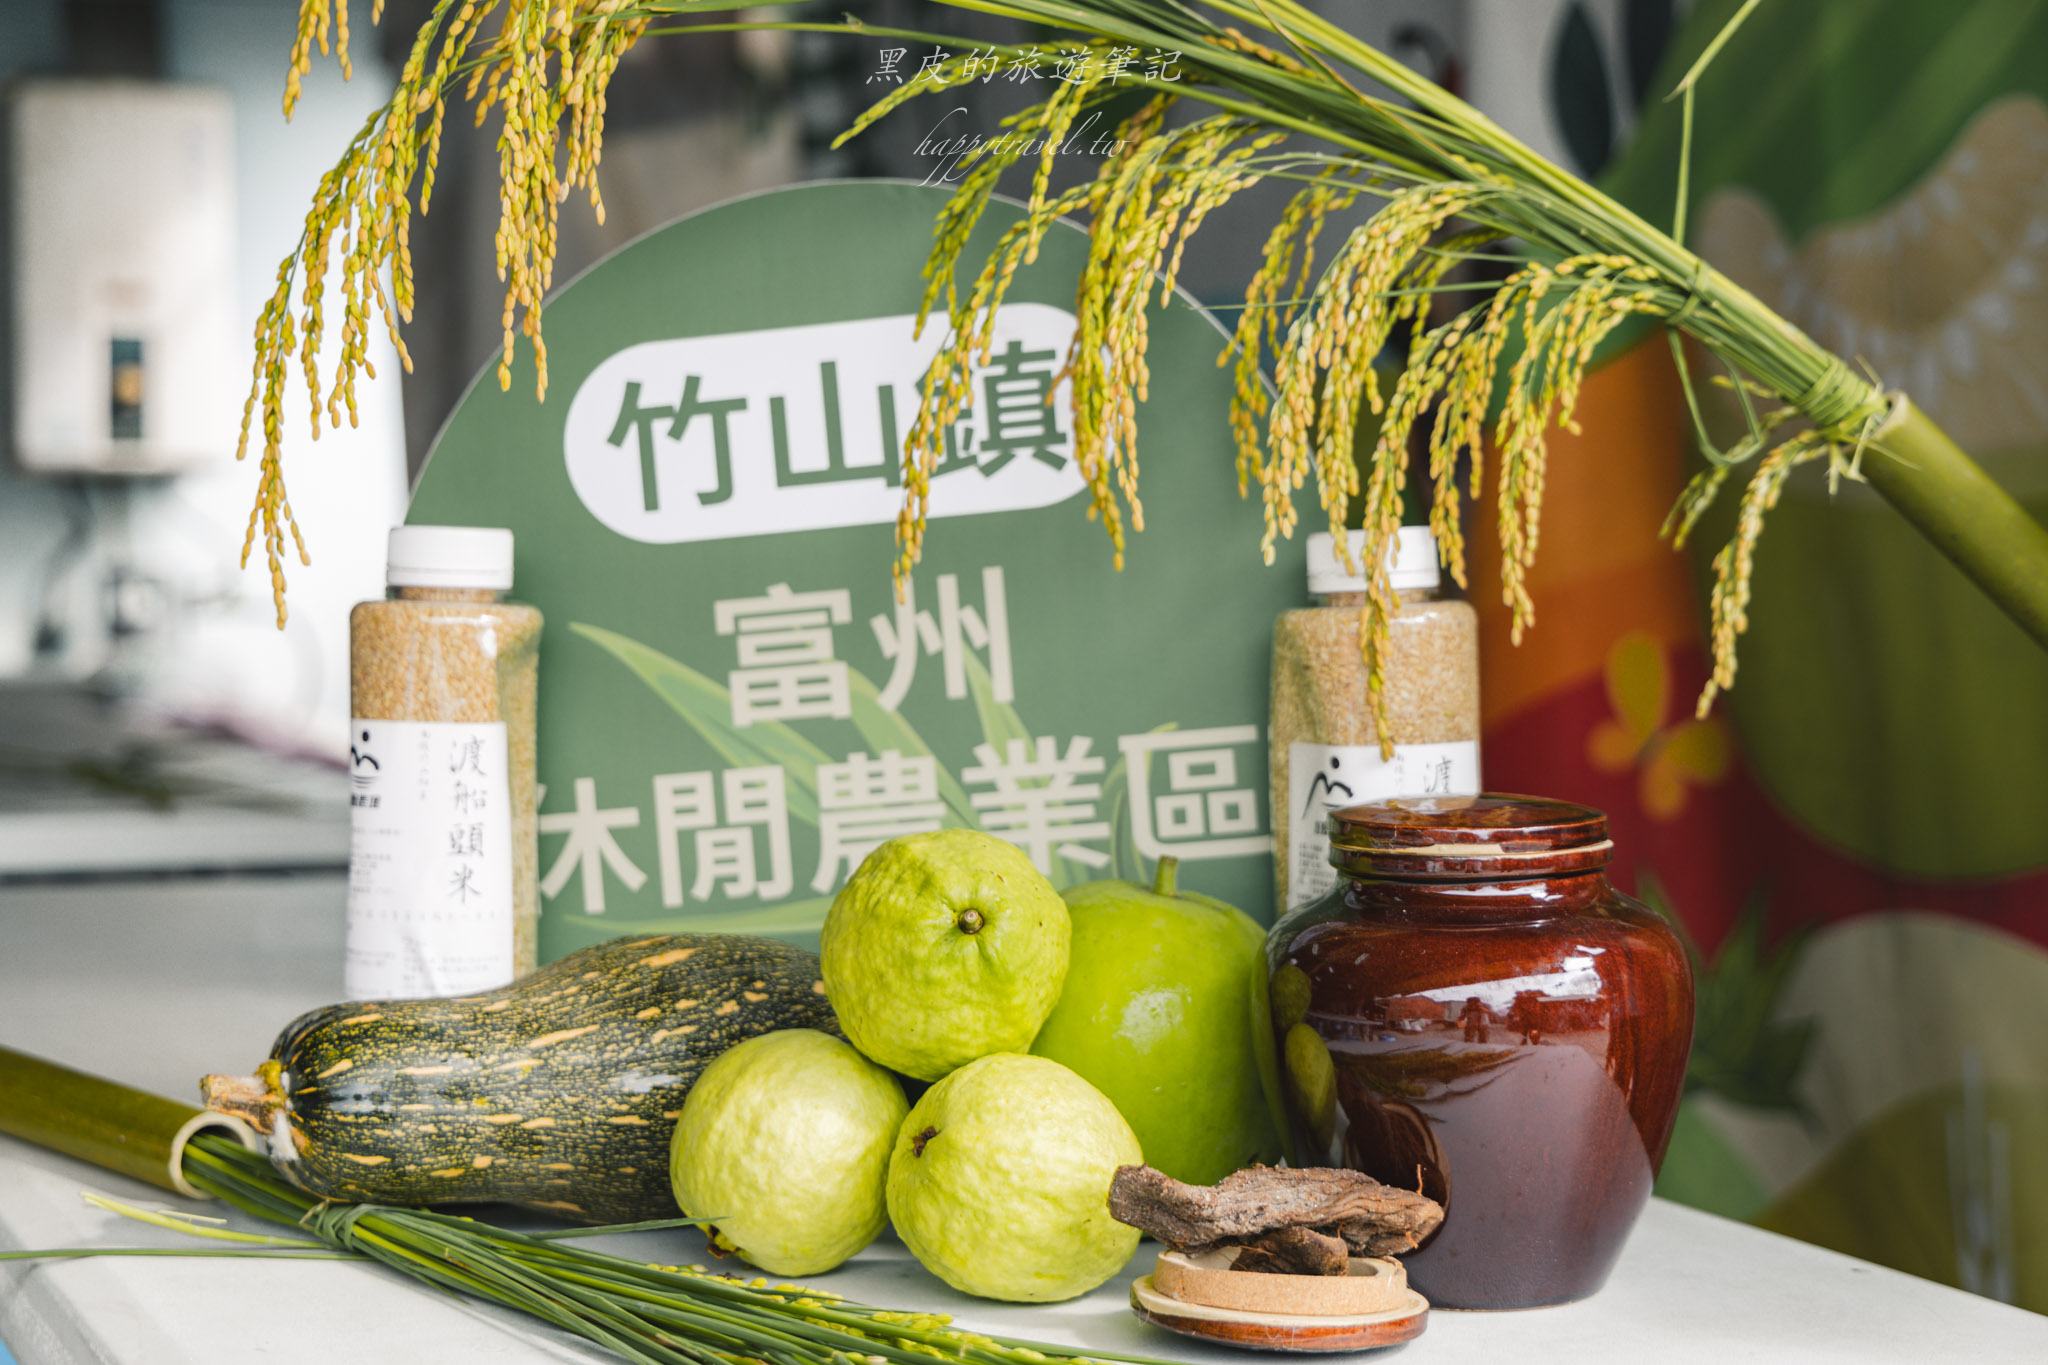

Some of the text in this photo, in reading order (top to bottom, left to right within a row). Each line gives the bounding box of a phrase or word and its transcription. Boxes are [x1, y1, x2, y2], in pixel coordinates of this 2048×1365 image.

[607, 340, 1067, 511] 竹山鎮
[714, 566, 1014, 727] 富州
[448, 734, 488, 904] 渡船頭米
